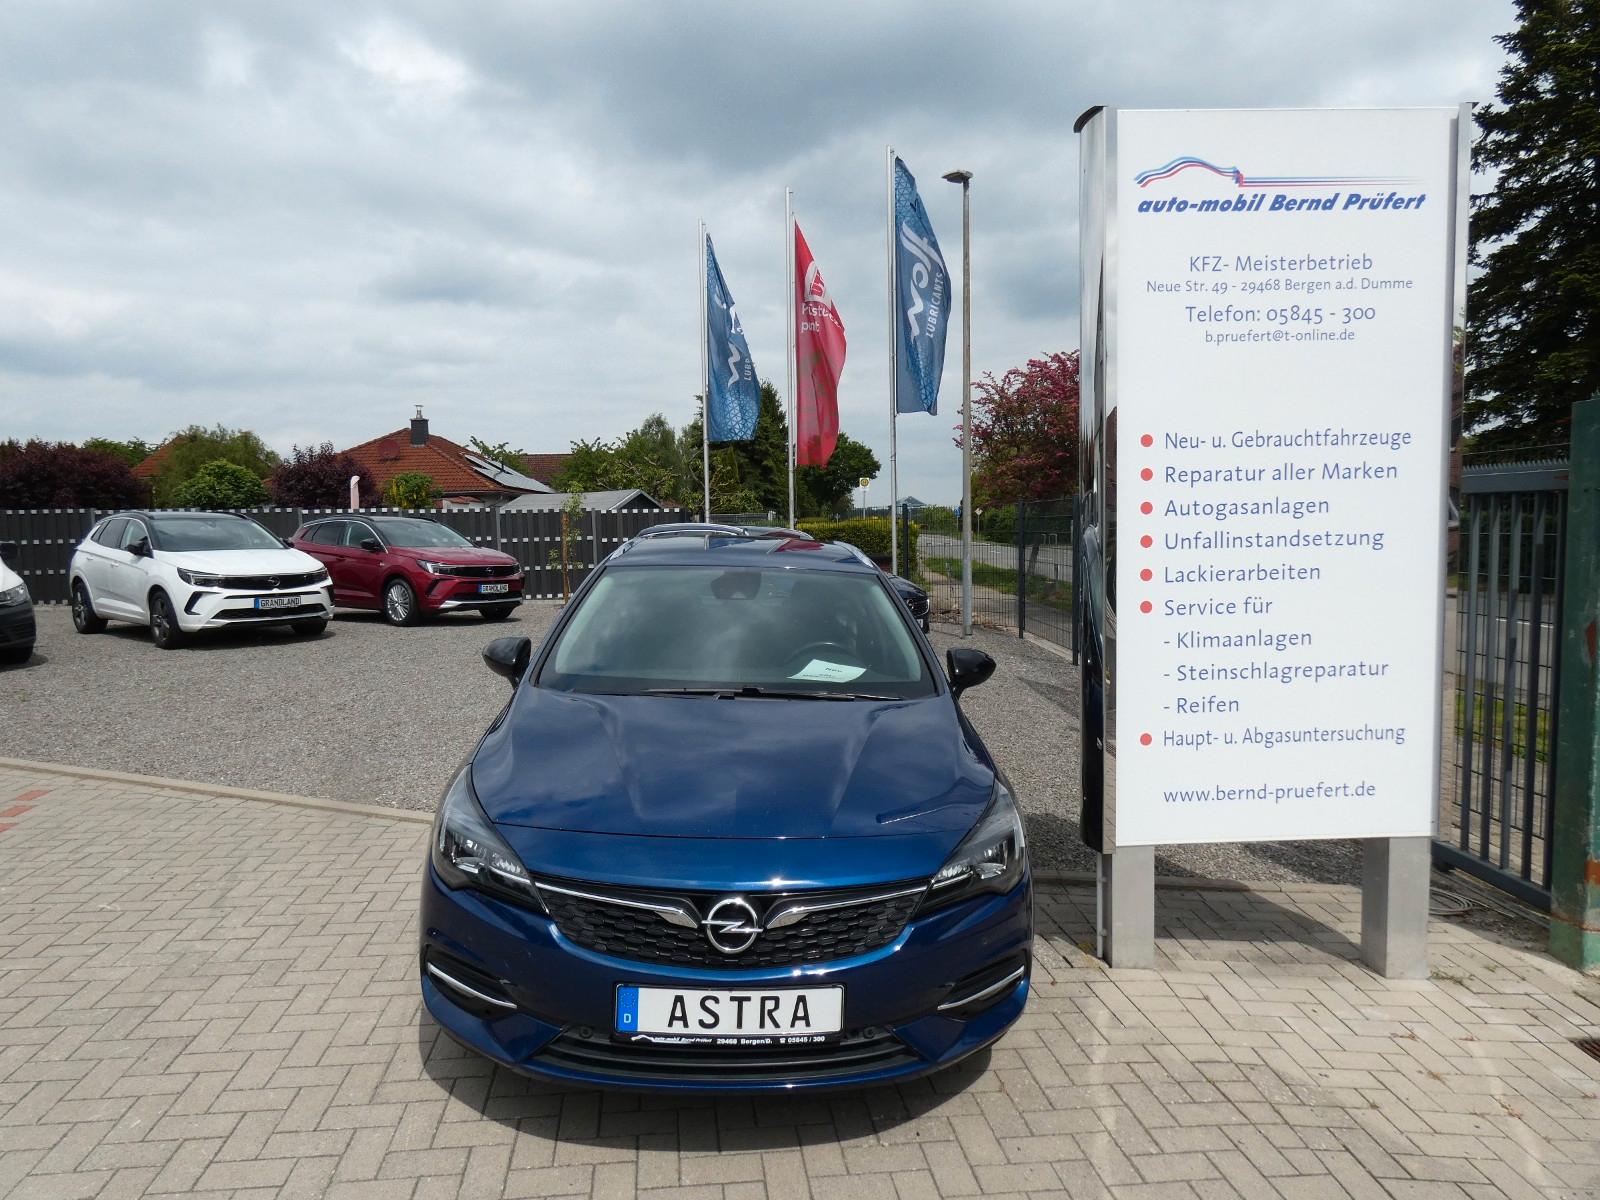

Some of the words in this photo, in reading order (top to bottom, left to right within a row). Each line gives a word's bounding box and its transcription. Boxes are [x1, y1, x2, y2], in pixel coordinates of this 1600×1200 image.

[1138, 193, 1266, 213] auto-mobil
[1268, 193, 1339, 212] Bernd
[1342, 192, 1426, 211] Prüfert
[1189, 256, 1229, 272] KFZ-
[1235, 253, 1373, 272] Meisterbetrieb
[1146, 280, 1181, 293] Neue
[1185, 279, 1209, 292] Str.
[1211, 281, 1228, 295] 49
[1240, 278, 1281, 294] 29468
[1284, 277, 1331, 292] Bergen
[1335, 276, 1357, 290] a.d.
[1361, 276, 1414, 290] Dumme
[926, 272, 943, 338] LUBRICANTS
[1185, 304, 1261, 323] Telefon:
[1266, 304, 1324, 325] 05845
[1341, 307, 1376, 324] 300
[1205, 328, 1355, 346] b.pruefert@t-online.de
[1165, 432, 1206, 449] Neu-
[1212, 434, 1226, 448] u.
[1231, 428, 1412, 450] Gebrauchtfahrzeuge
[1165, 466, 1266, 488] Reparatur
[1272, 463, 1315, 481] aller
[1322, 461, 1398, 481] Marken
[1164, 496, 1329, 521] Autogasanlagen
[1165, 529, 1384, 551] Unfallinstandsetzung
[1165, 563, 1320, 583] Lackierarbeiten
[260, 597, 300, 607] GRANDLAND
[1165, 598, 1236, 616] Service
[1243, 597, 1273, 614] für
[1177, 629, 1312, 651] Klimaanlagen
[1177, 661, 1389, 683] Steinschlagreparatur
[1177, 695, 1239, 714] Reifen
[1164, 730, 1219, 751] Haupt-
[1224, 732, 1238, 745] u.
[1242, 724, 1406, 748] Abgasuntersuchung
[1164, 781, 1376, 804] www.bernd-pruefert.de
[623, 1013, 632, 1024] D
[667, 994, 812, 1029] ASTRA
